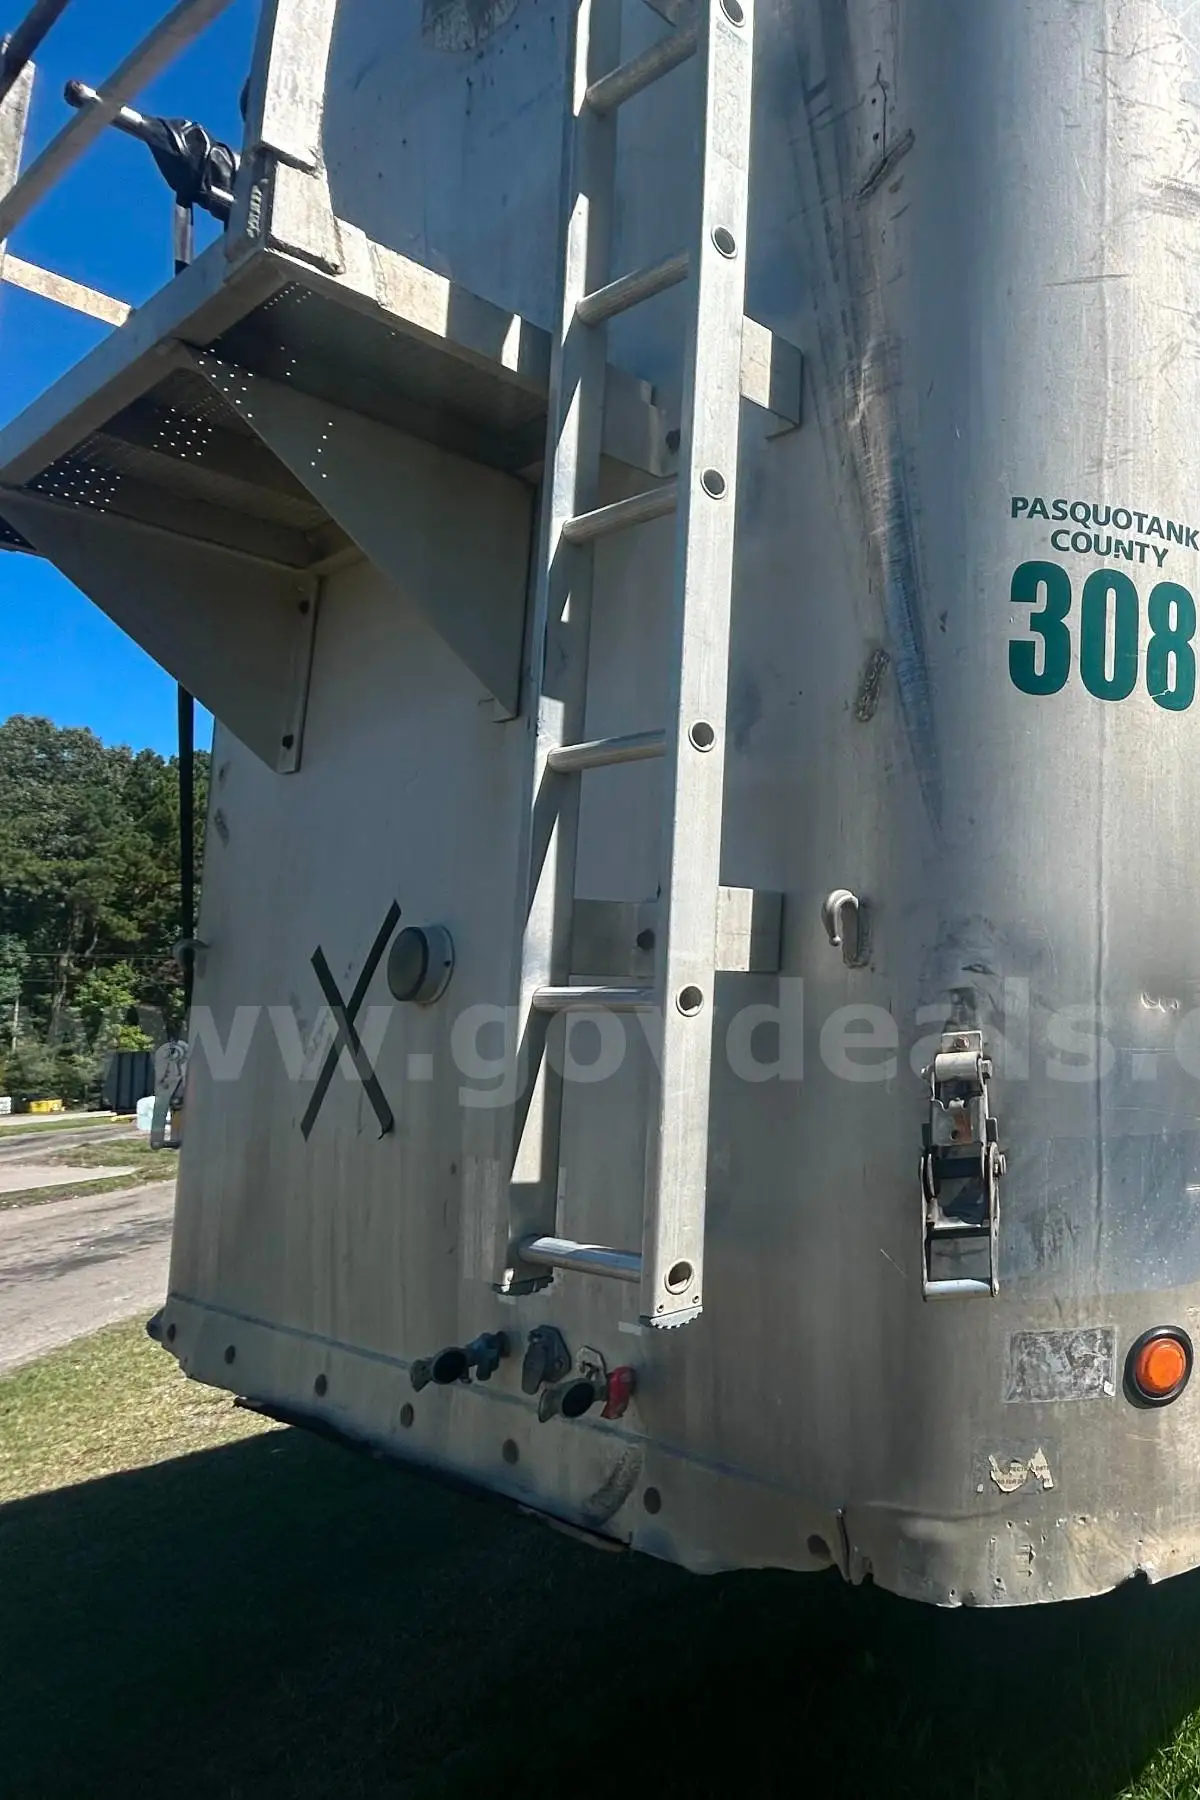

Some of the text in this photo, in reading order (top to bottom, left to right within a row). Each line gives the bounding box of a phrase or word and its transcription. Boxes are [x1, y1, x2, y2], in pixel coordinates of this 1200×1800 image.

[1011, 497, 1200, 551] PASQUOTANK
[1050, 529, 1169, 568] COUNTY
[1008, 560, 1197, 712] 308
